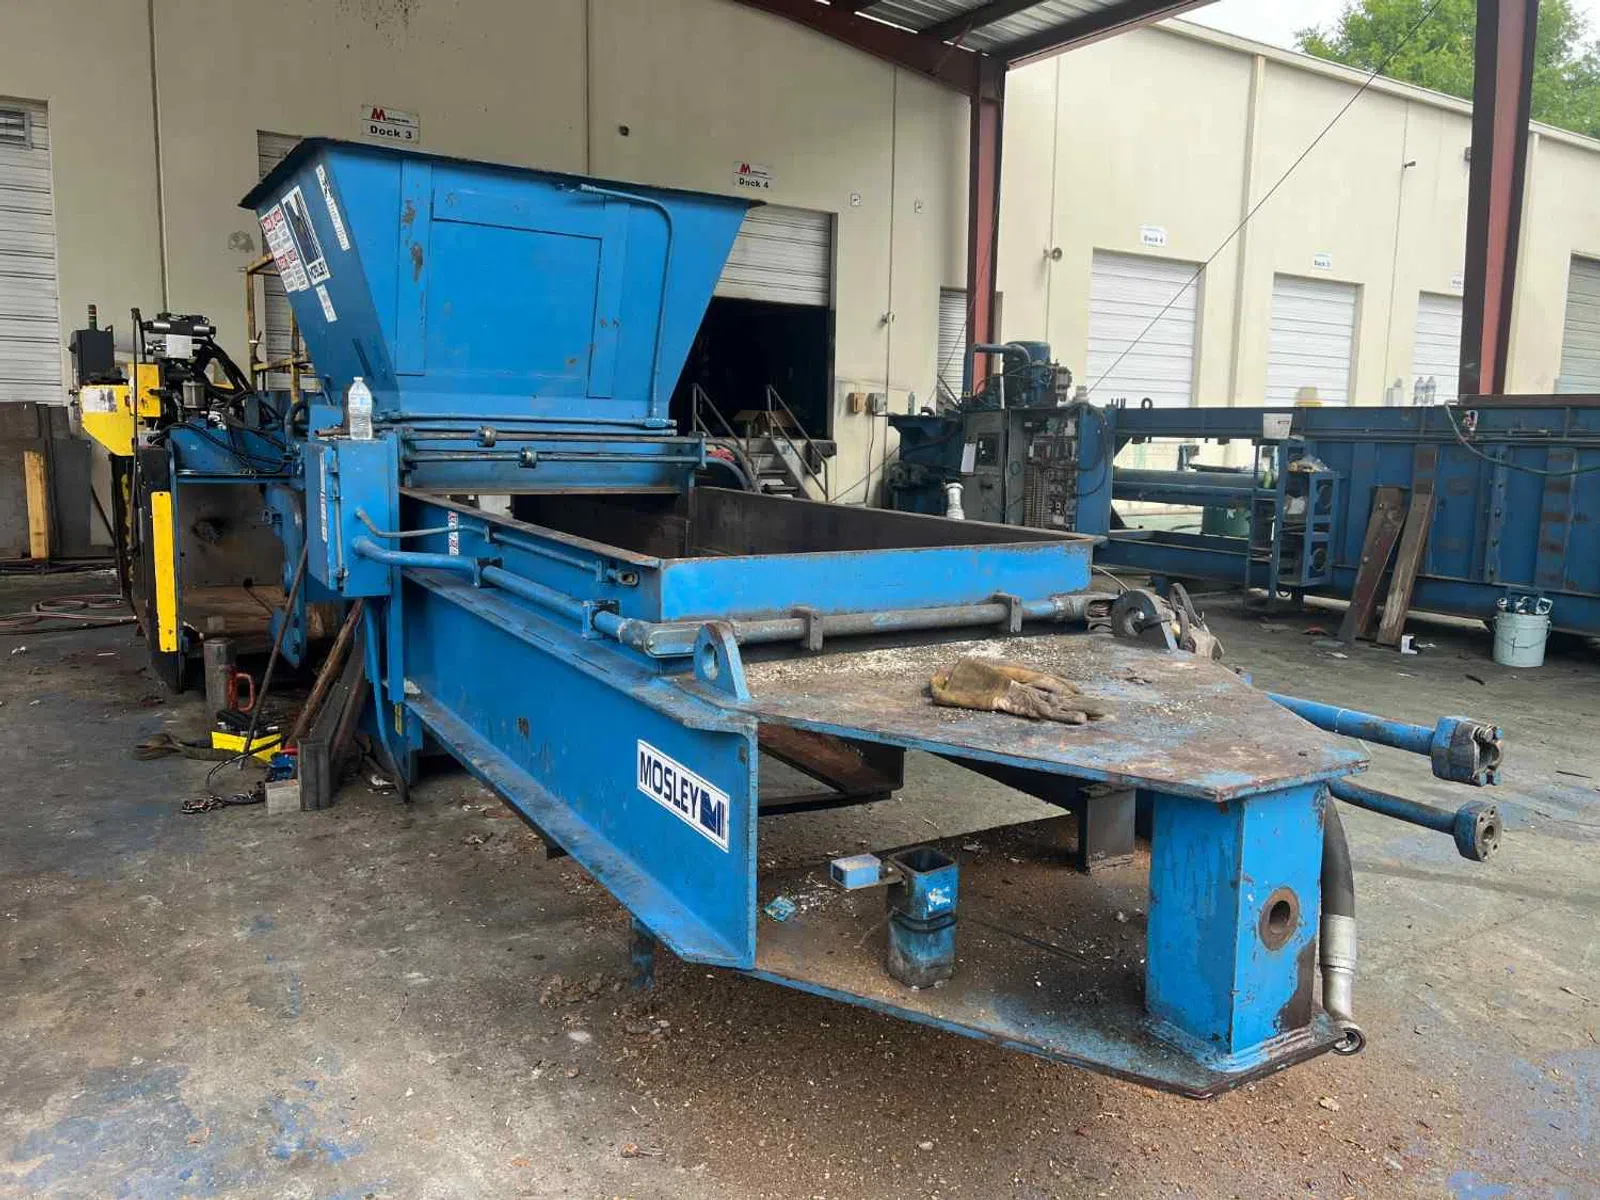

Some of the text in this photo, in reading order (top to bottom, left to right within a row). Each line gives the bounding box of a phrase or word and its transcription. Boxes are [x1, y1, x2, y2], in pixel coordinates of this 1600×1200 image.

[370, 125, 412, 139] Dock 3
[739, 177, 760, 188] Dock
[640, 751, 699, 819] MOSLEY
